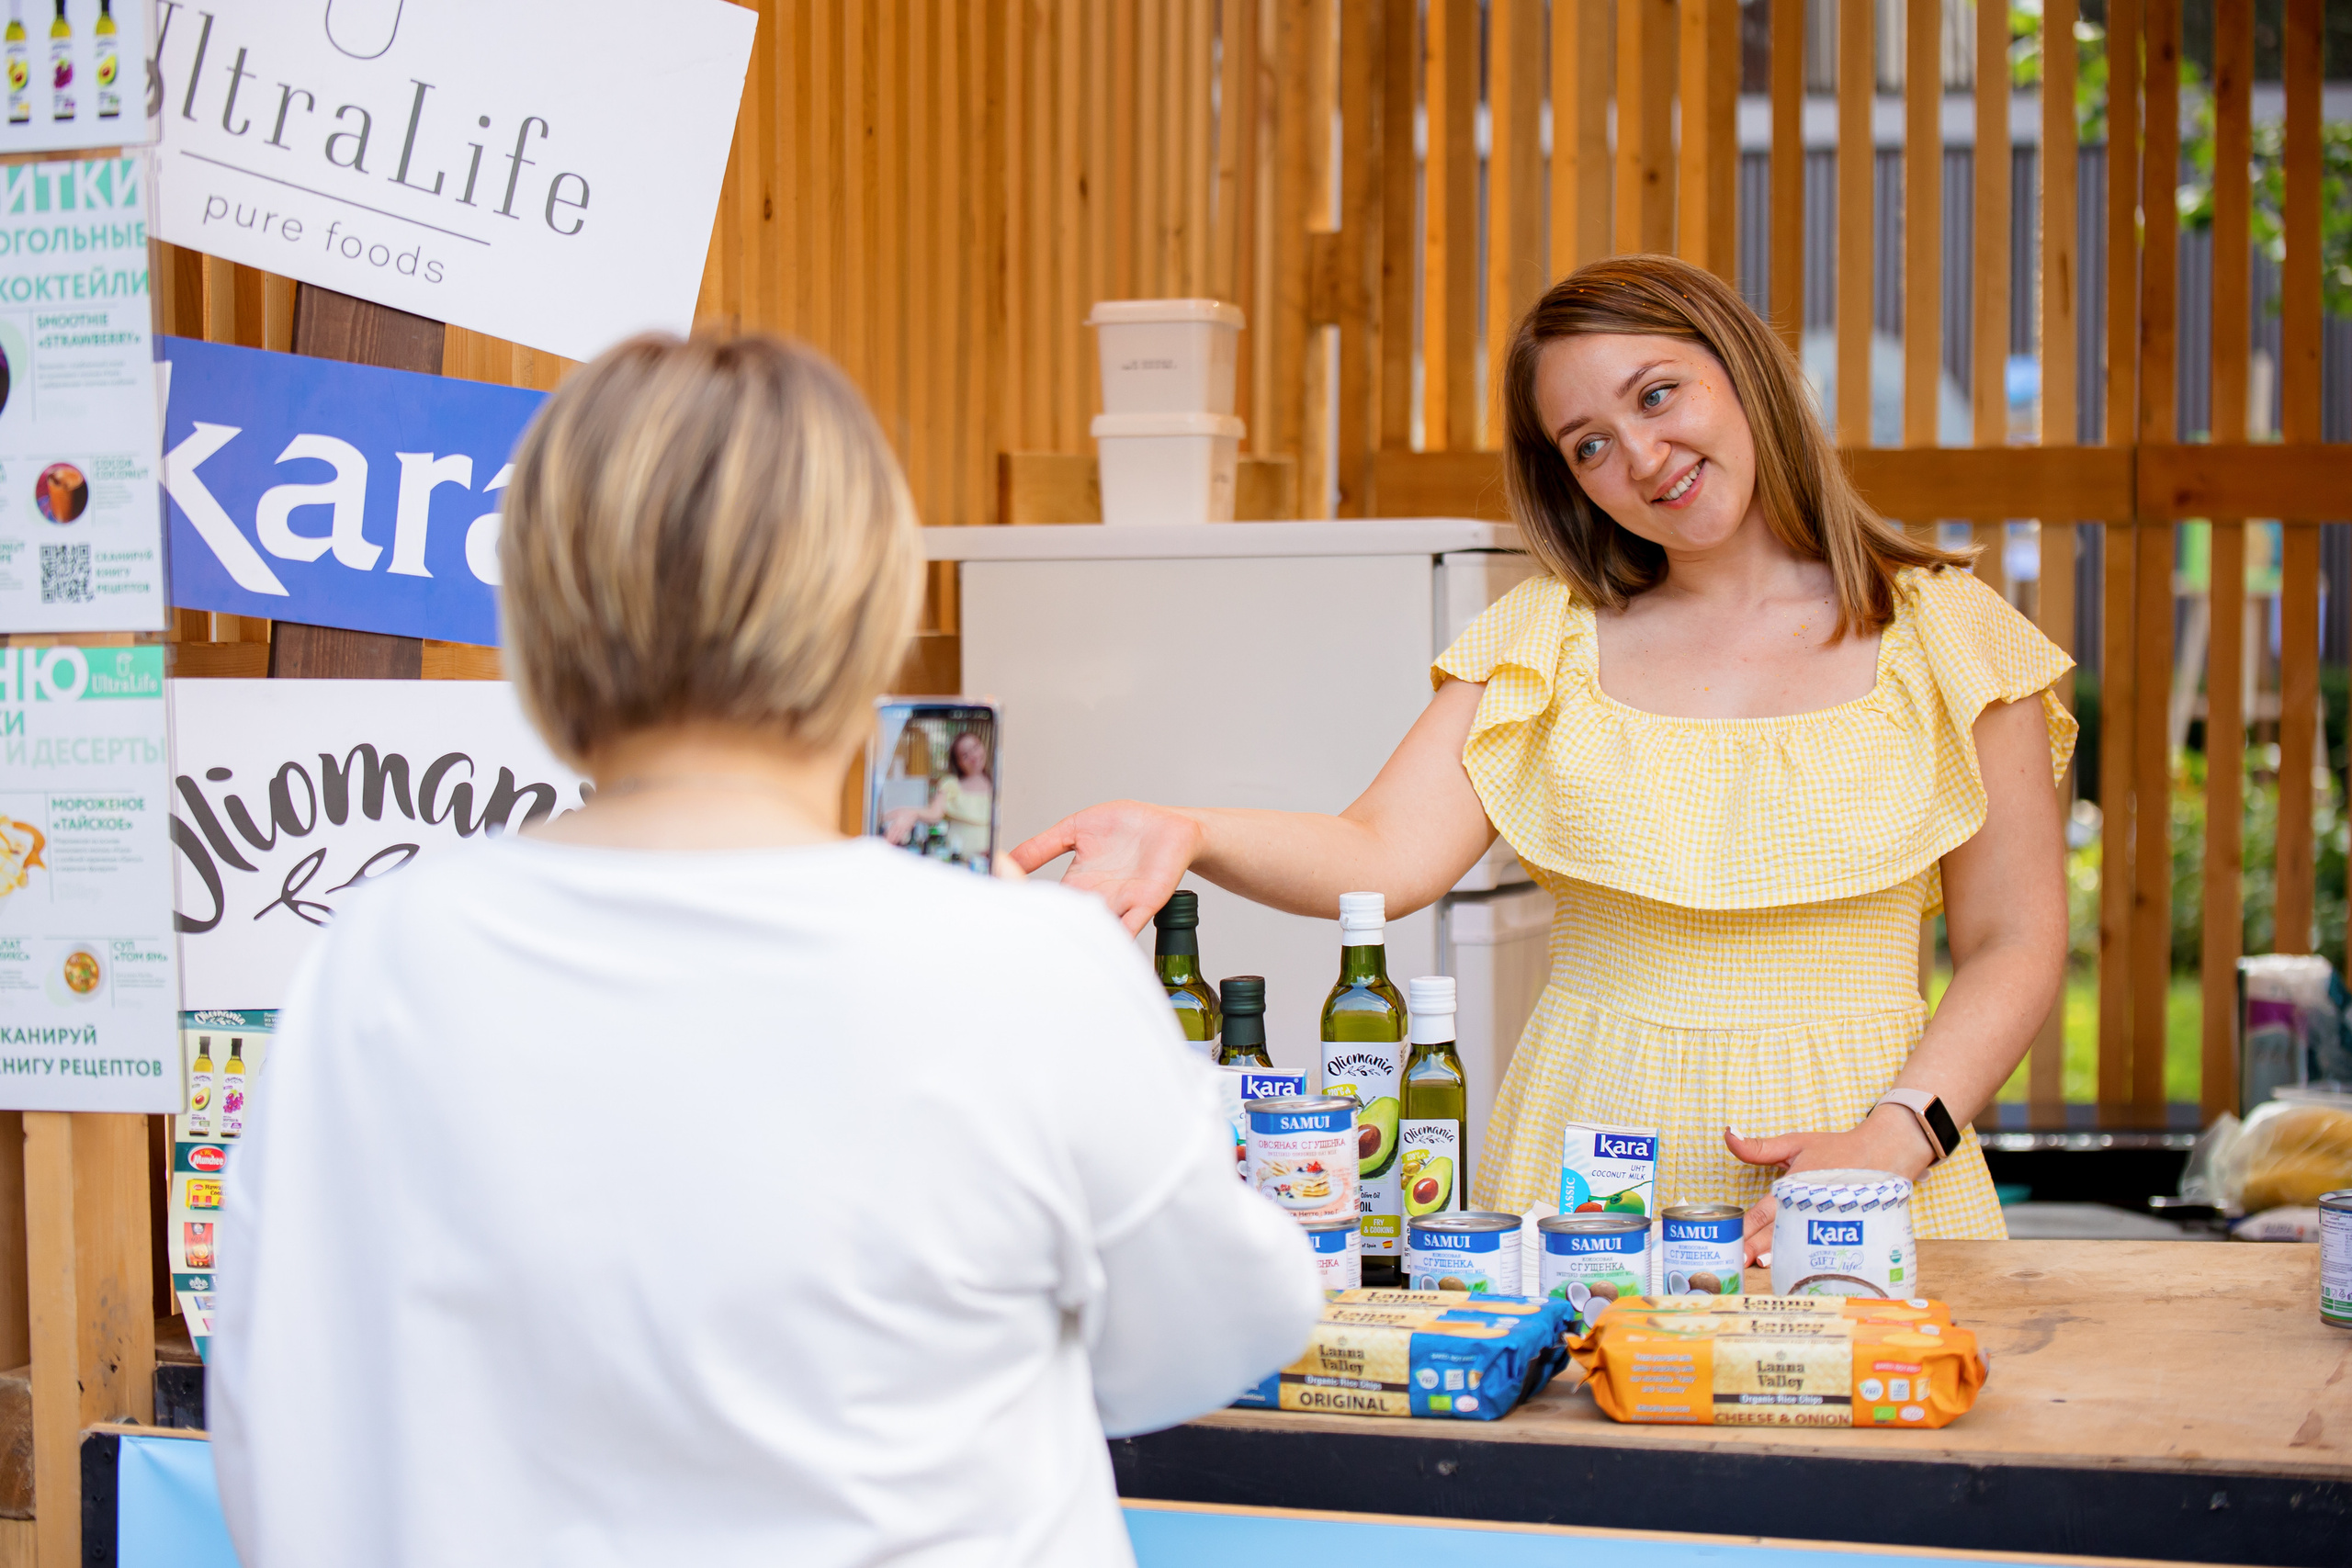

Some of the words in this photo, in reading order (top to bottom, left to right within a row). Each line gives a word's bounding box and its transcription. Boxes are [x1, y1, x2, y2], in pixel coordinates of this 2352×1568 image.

[202, 191, 304, 244] pure
[325, 220, 446, 286] foods
[92, 671, 158, 694] UltraLife
[6, 739, 27, 766] И
[31, 737, 166, 770] ДЕСЕРТЫ
[51, 797, 146, 812] МОРОЖЕНОЕ
[53, 814, 134, 831] «ТАЙСКОЕ»
[0, 1058, 53, 1076] НИГУ
[60, 1059, 164, 1078] РЕЦЕПТОВ
[1327, 1053, 1395, 1077] Oliomania
[1246, 1076, 1297, 1099] kara
[1281, 1115, 1330, 1130] SAMUI
[1403, 1125, 1455, 1145] Oliomania
[1258, 1140, 1297, 1150] ОВСЯНАЯ
[1600, 1134, 1649, 1158] kara
[1591, 1169, 1626, 1179] COCONUT
[1628, 1173, 1645, 1181] MILK
[1373, 1218, 1385, 1226] FRY
[1369, 1226, 1395, 1235] COOKING
[1669, 1224, 1719, 1239] SAMUI
[1812, 1221, 1860, 1246] kara
[1423, 1234, 1471, 1248] SAMUI
[1571, 1237, 1623, 1251] SAMUI
[1570, 1262, 1625, 1272] СГУЩЕНКА
[1810, 1258, 1837, 1268] GIFT
[1318, 1343, 1365, 1359] Lanna
[1321, 1359, 1365, 1376] Valley
[1756, 1359, 1805, 1373] Lanna
[1304, 1374, 1339, 1387] Organic
[1340, 1379, 1359, 1388] Rice
[1359, 1381, 1383, 1392] Chips
[1757, 1374, 1804, 1391] Valley
[1299, 1392, 1390, 1412] ORIGINAL
[1739, 1393, 1776, 1405] Organic
[1776, 1393, 1797, 1404] Rice
[1798, 1394, 1824, 1405] Chips
[1714, 1412, 1775, 1424] CHEESE
[1780, 1413, 1791, 1424] &
[1794, 1412, 1850, 1425] ONION
